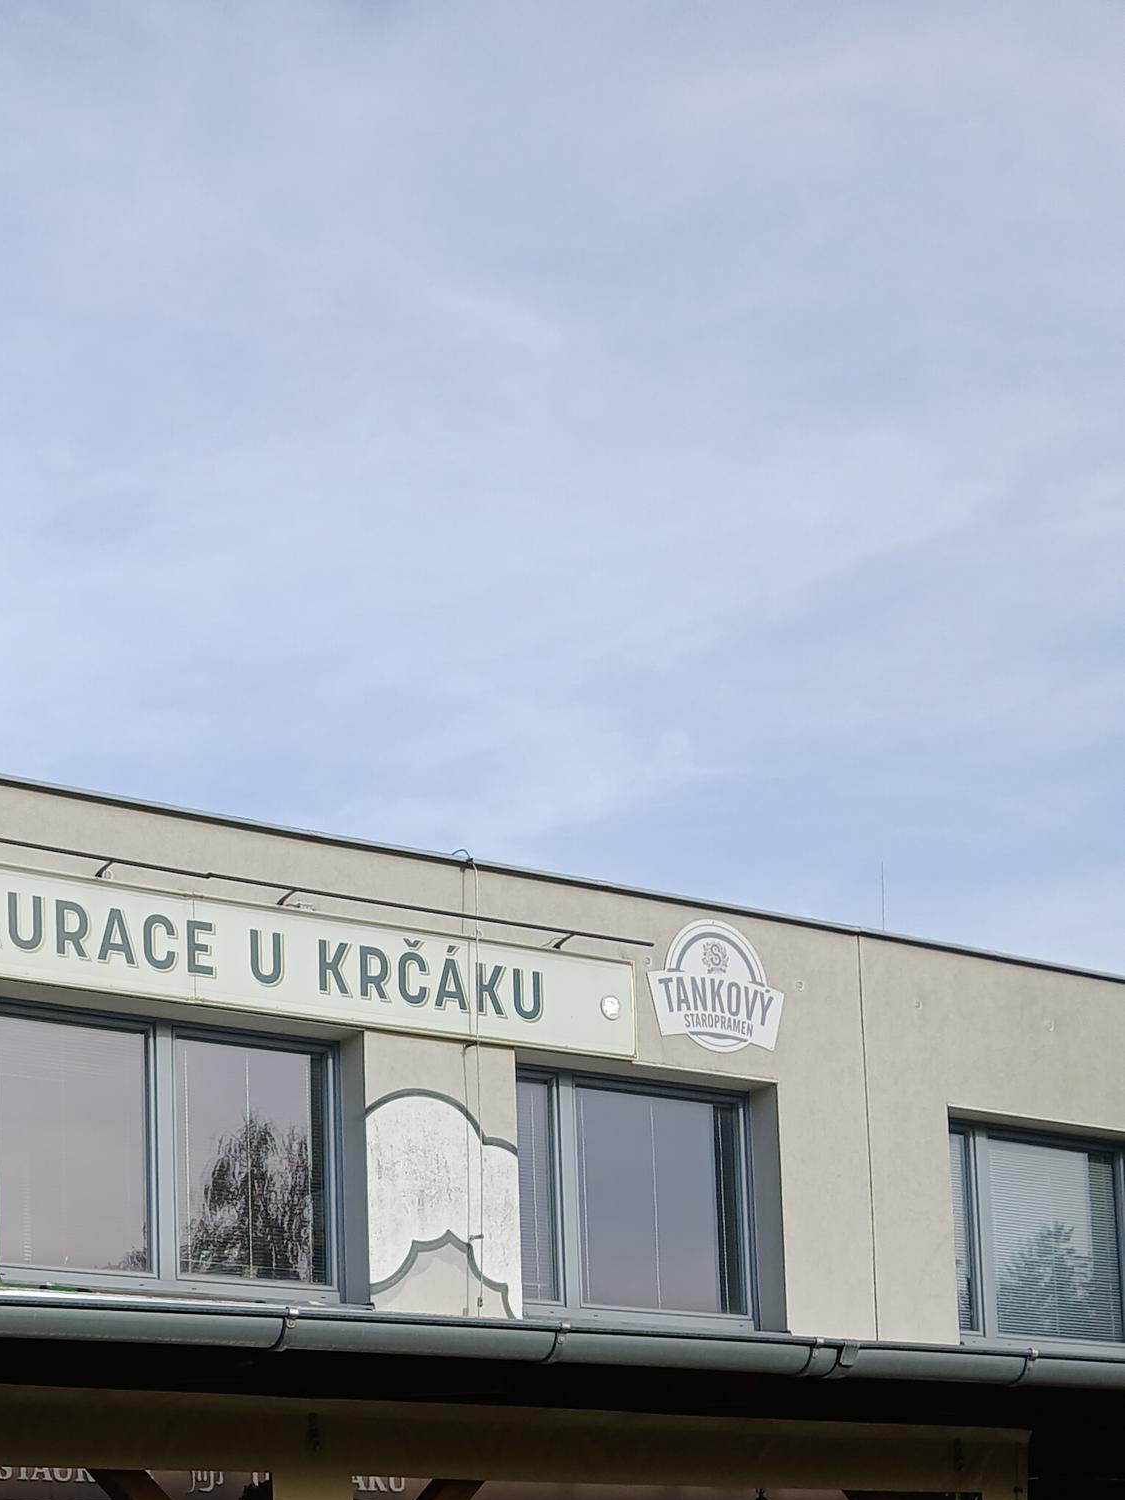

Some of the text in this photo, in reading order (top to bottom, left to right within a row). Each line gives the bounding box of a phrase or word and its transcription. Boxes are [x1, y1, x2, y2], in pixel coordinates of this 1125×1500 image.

[249, 928, 284, 985] U
[318, 937, 545, 1024] KRČÁKU
[658, 975, 774, 1027] TANKOVÝ
[683, 1013, 754, 1038] STAROPRAMEN
